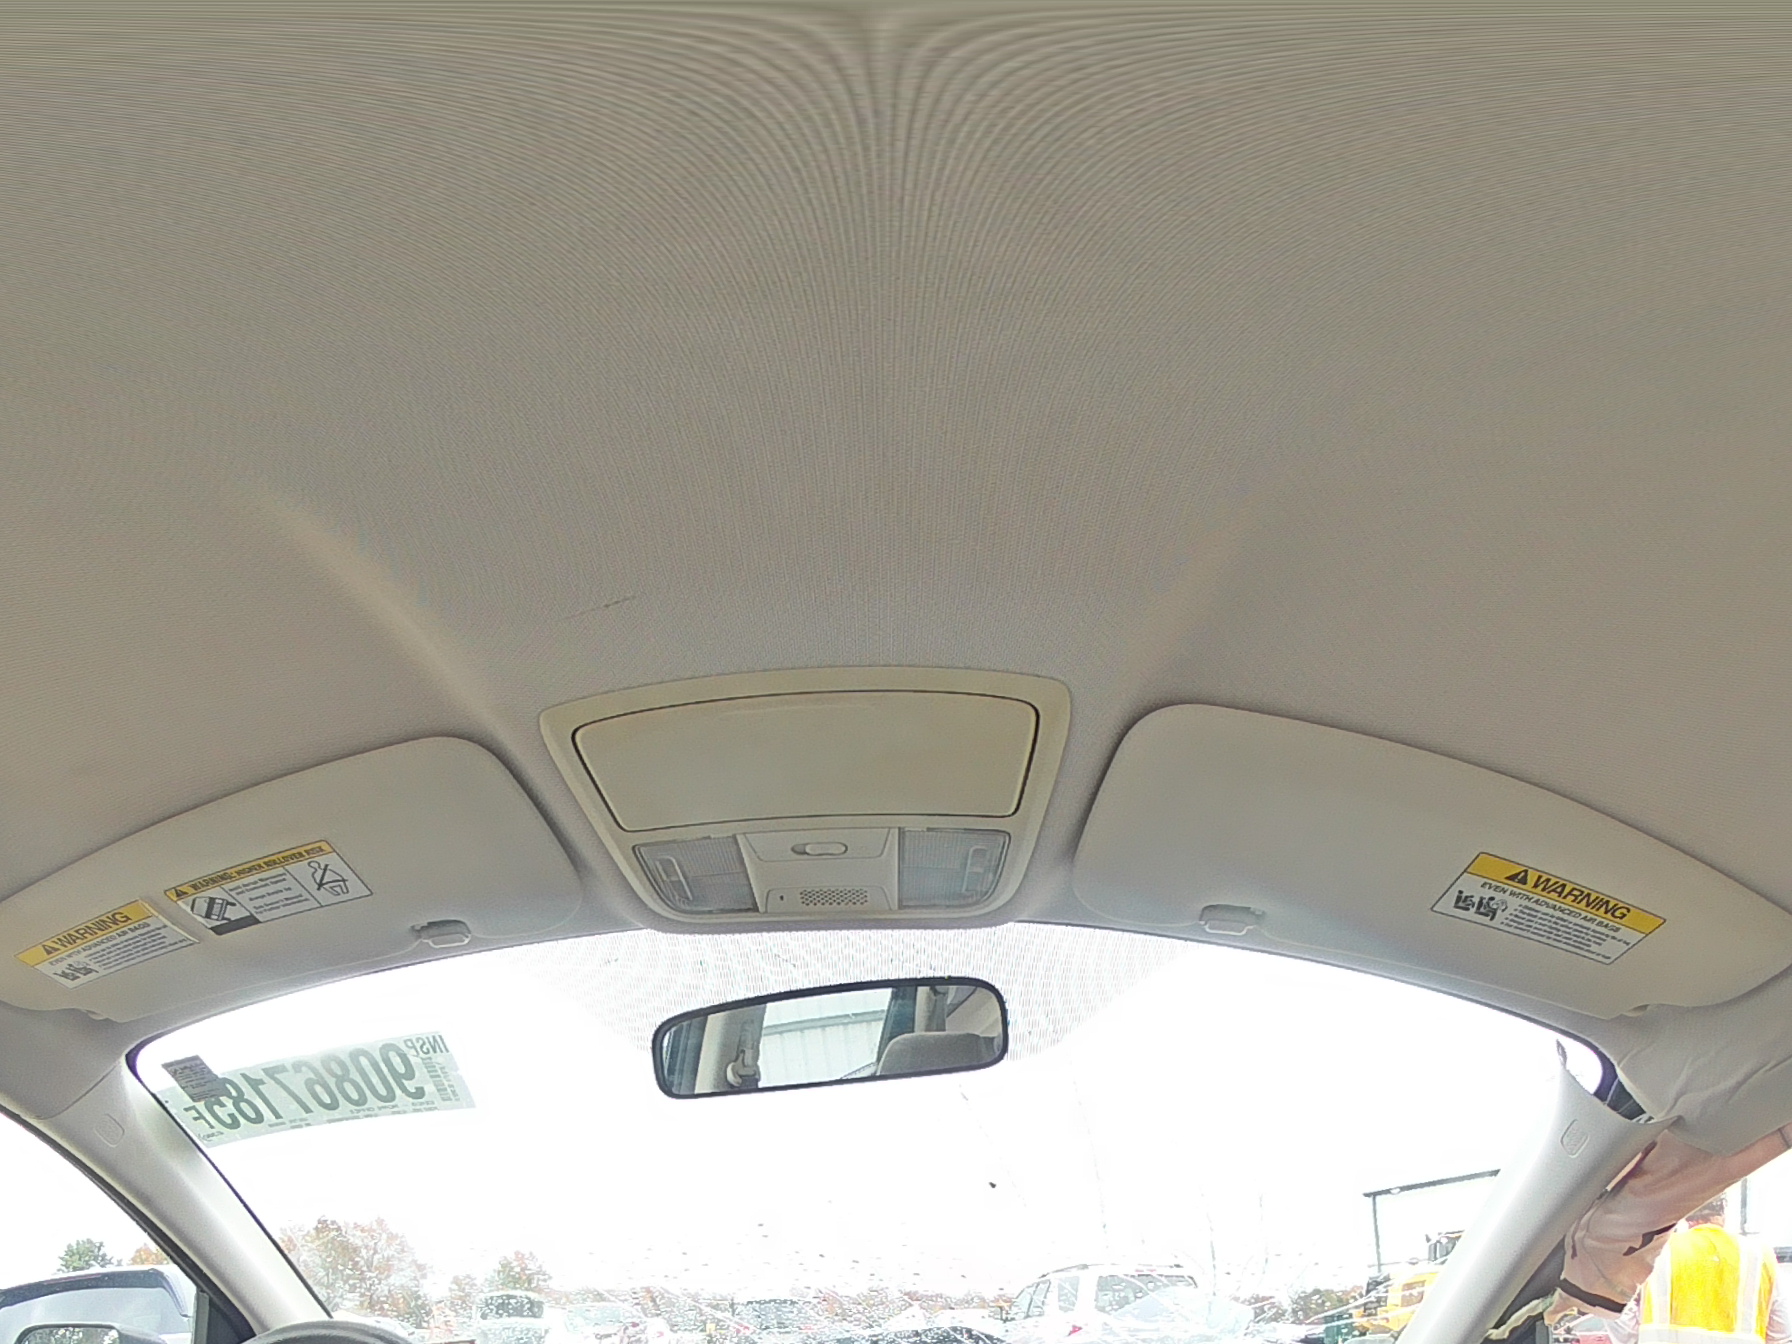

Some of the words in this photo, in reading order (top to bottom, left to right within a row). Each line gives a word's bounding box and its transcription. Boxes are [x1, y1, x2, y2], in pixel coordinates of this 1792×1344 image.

[1480, 881, 1508, 894] EVEN
[1508, 889, 1532, 902] WITH
[1531, 898, 1582, 918] ADVANCED
[1531, 874, 1631, 921] WARNING
[56, 911, 133, 951] WARNING
